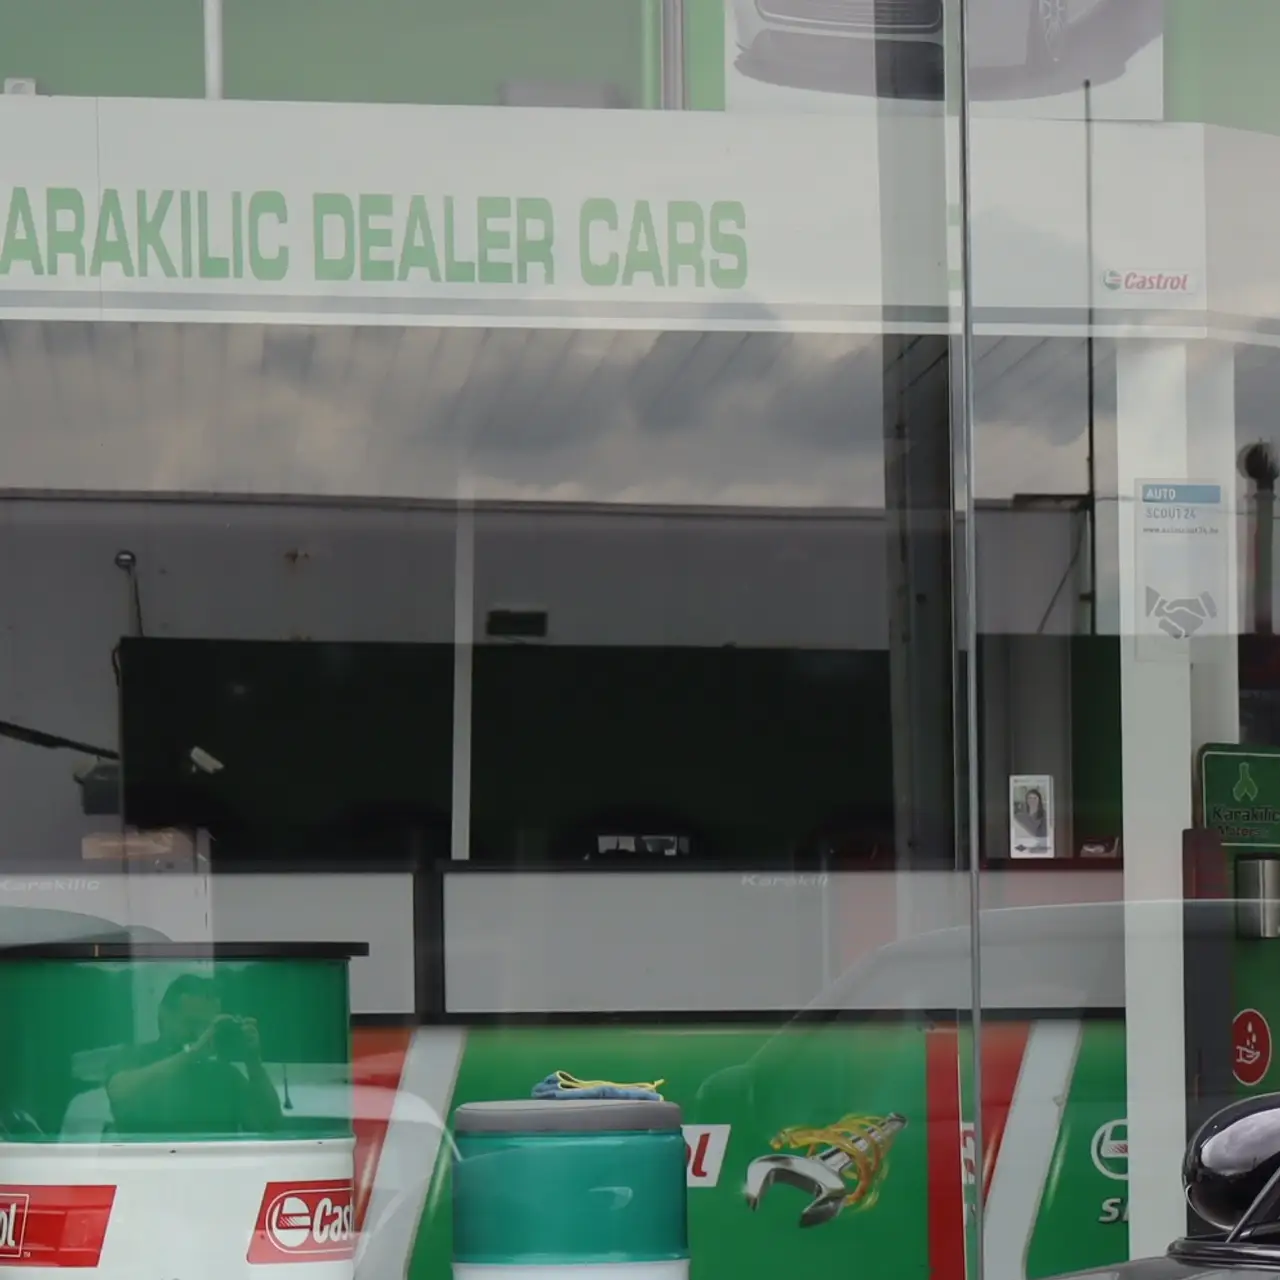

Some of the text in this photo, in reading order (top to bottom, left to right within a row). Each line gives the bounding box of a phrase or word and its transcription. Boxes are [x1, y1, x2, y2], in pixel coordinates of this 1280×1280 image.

[0, 186, 748, 290] ARAKILIC DEALER CARS
[1124, 271, 1189, 291] Castrol
[1146, 488, 1176, 500] AUTO
